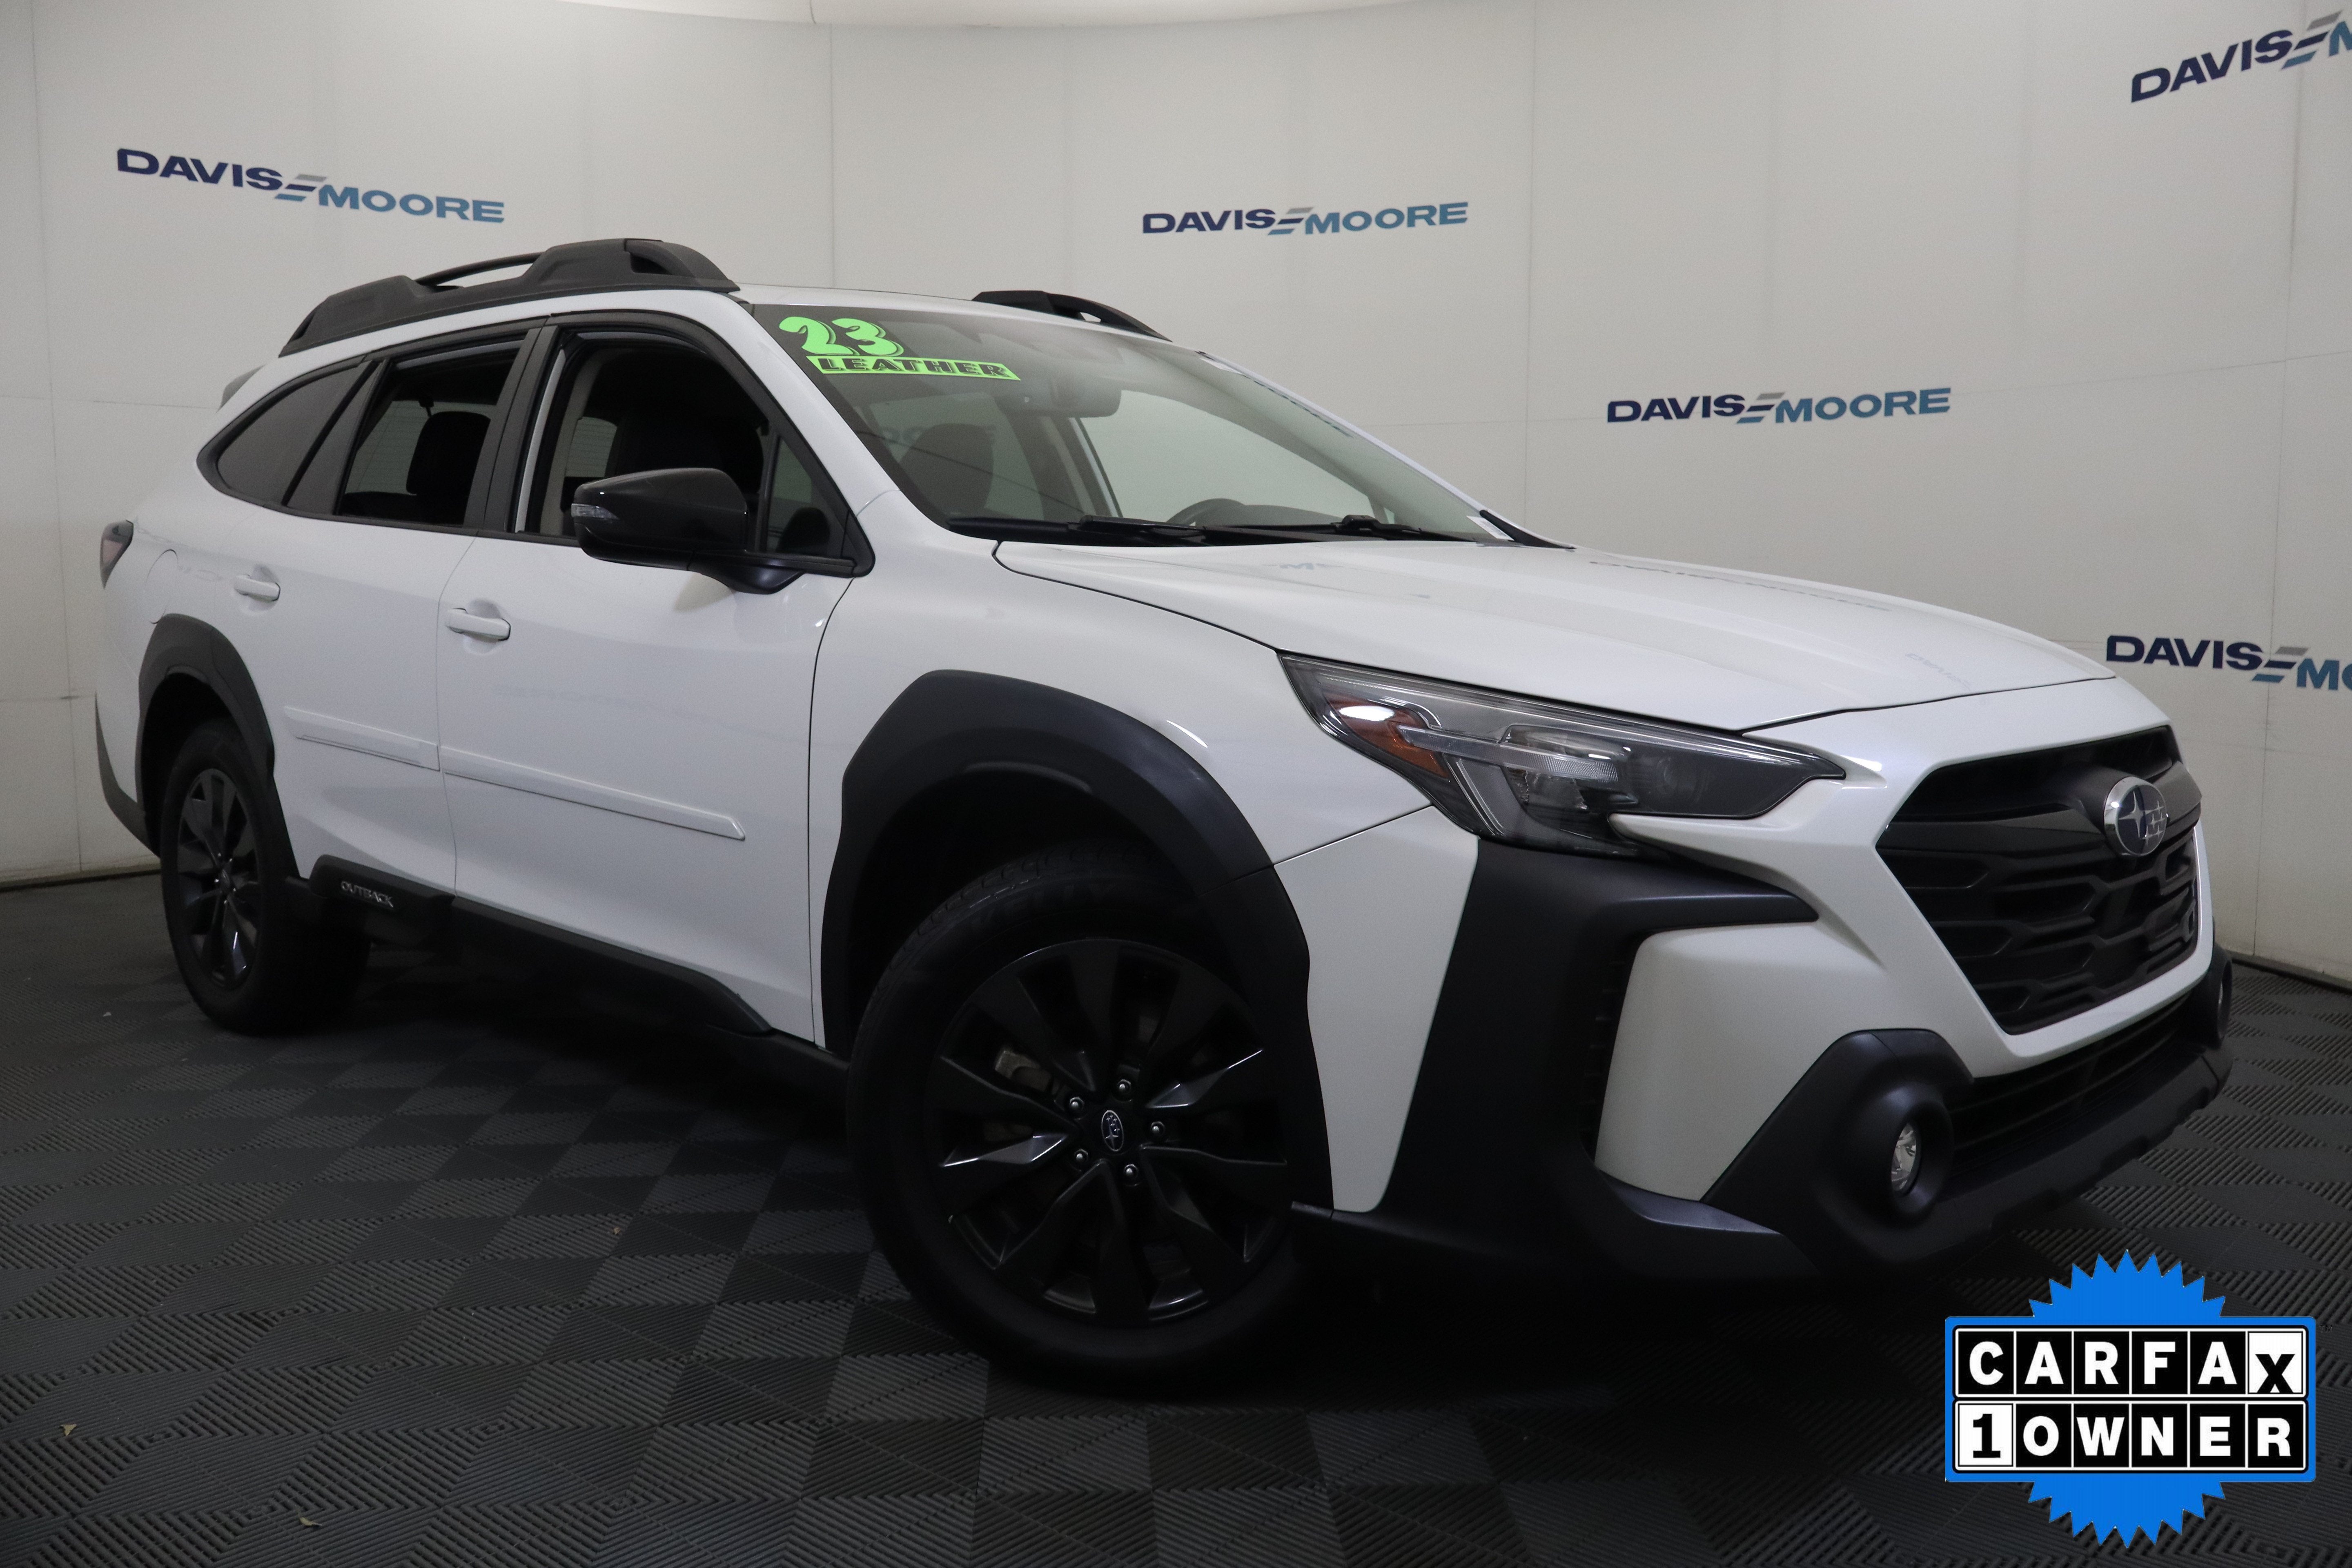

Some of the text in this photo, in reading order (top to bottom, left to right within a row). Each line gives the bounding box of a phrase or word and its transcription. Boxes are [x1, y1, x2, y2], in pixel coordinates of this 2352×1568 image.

[2131, 29, 2293, 103] DAVIS
[116, 147, 504, 223] DAVIS MOORE
[1143, 202, 1468, 235] DAVIS MOORE
[779, 316, 904, 356] 23
[818, 358, 1014, 377] LEATHER
[1607, 387, 1951, 423] DAVIS MOORE
[2106, 635, 2263, 671] DAVIS
[341, 881, 394, 908] OUTBACK
